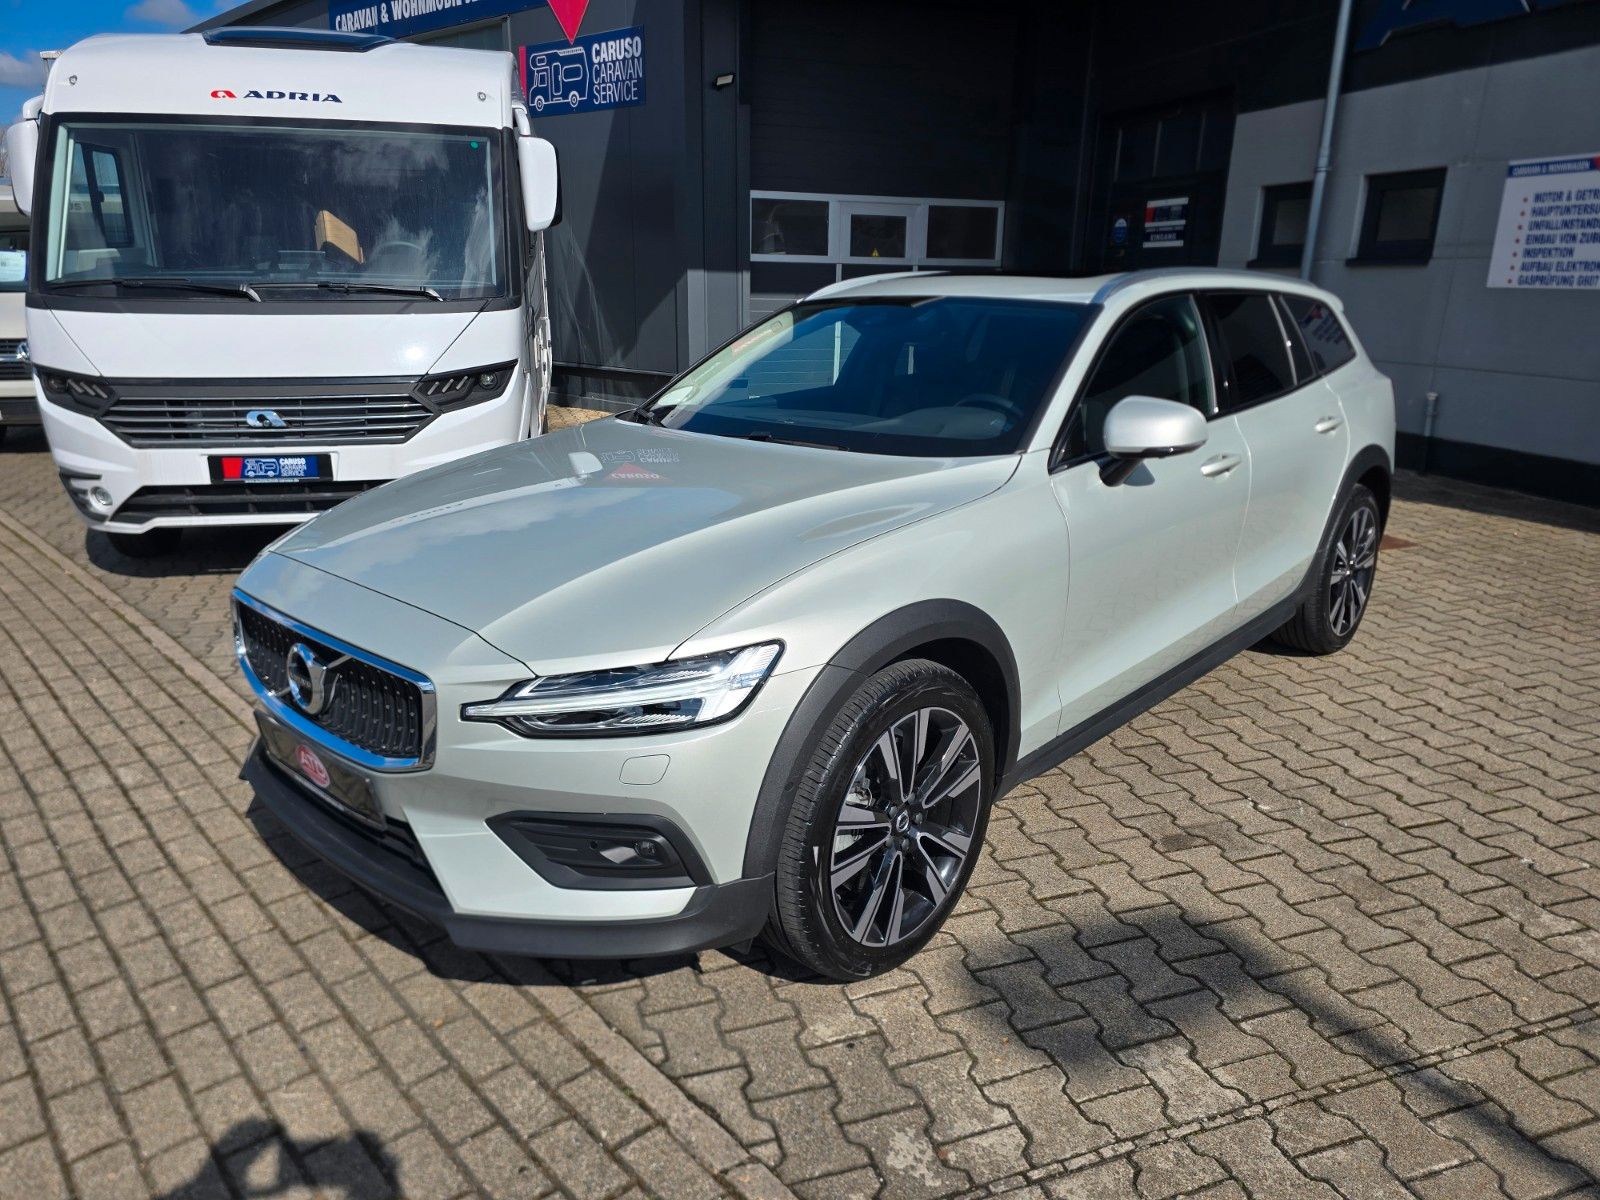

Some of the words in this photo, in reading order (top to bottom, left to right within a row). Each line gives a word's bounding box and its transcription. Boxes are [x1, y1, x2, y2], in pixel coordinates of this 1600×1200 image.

[335, 5, 378, 32] CARAVAN
[381, 3, 389, 23] &
[592, 36, 642, 63] CARUSO
[592, 57, 643, 84] CARAVAN
[243, 90, 343, 103] ADRIA
[593, 80, 638, 105] SERVICE
[1528, 218, 1600, 231] UNFALLINSTAND
[1523, 247, 1575, 259] INSPEKTION
